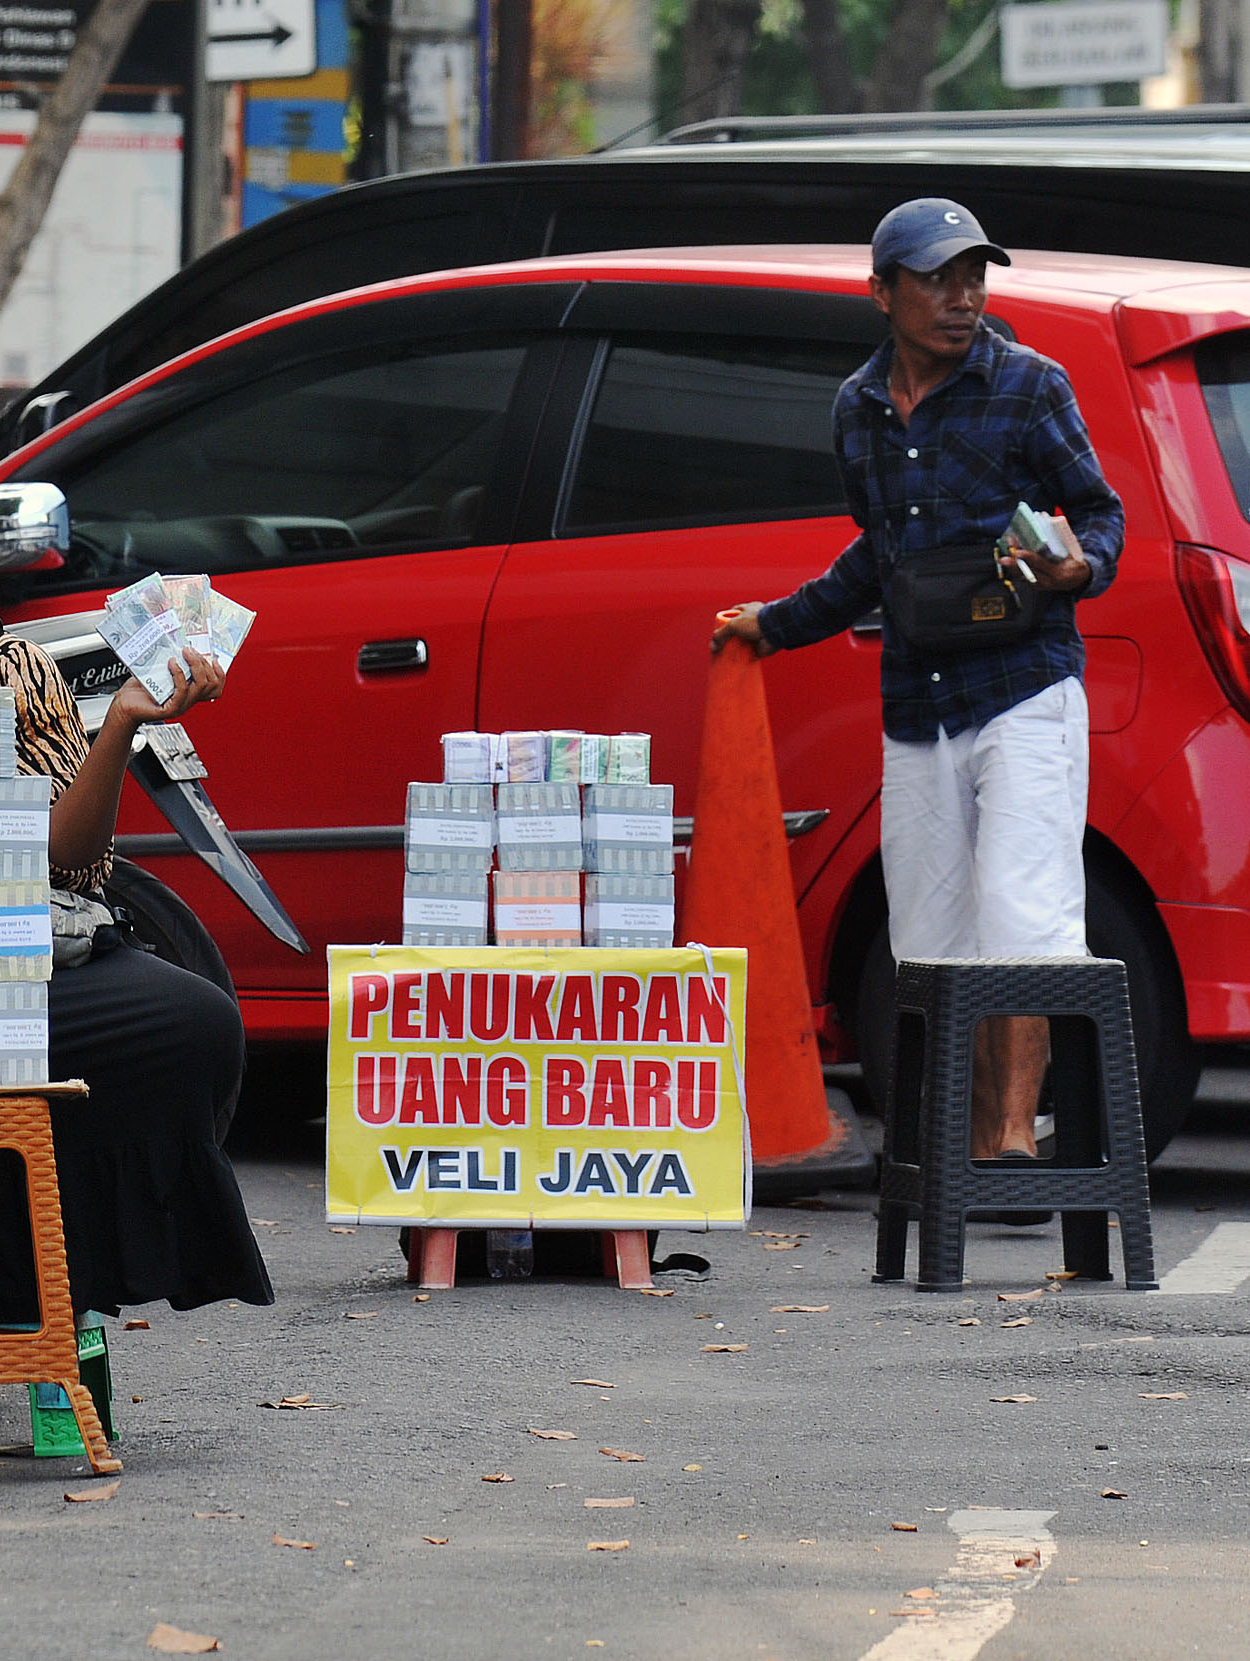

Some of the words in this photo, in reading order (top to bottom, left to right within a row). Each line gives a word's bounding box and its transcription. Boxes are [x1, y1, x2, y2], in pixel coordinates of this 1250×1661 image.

[348, 971, 728, 1045] PENUKARAN
[355, 1054, 528, 1129] UANG
[545, 1056, 719, 1130] BARU
[382, 1148, 517, 1192] VELI
[539, 1150, 694, 1195] JAYA
